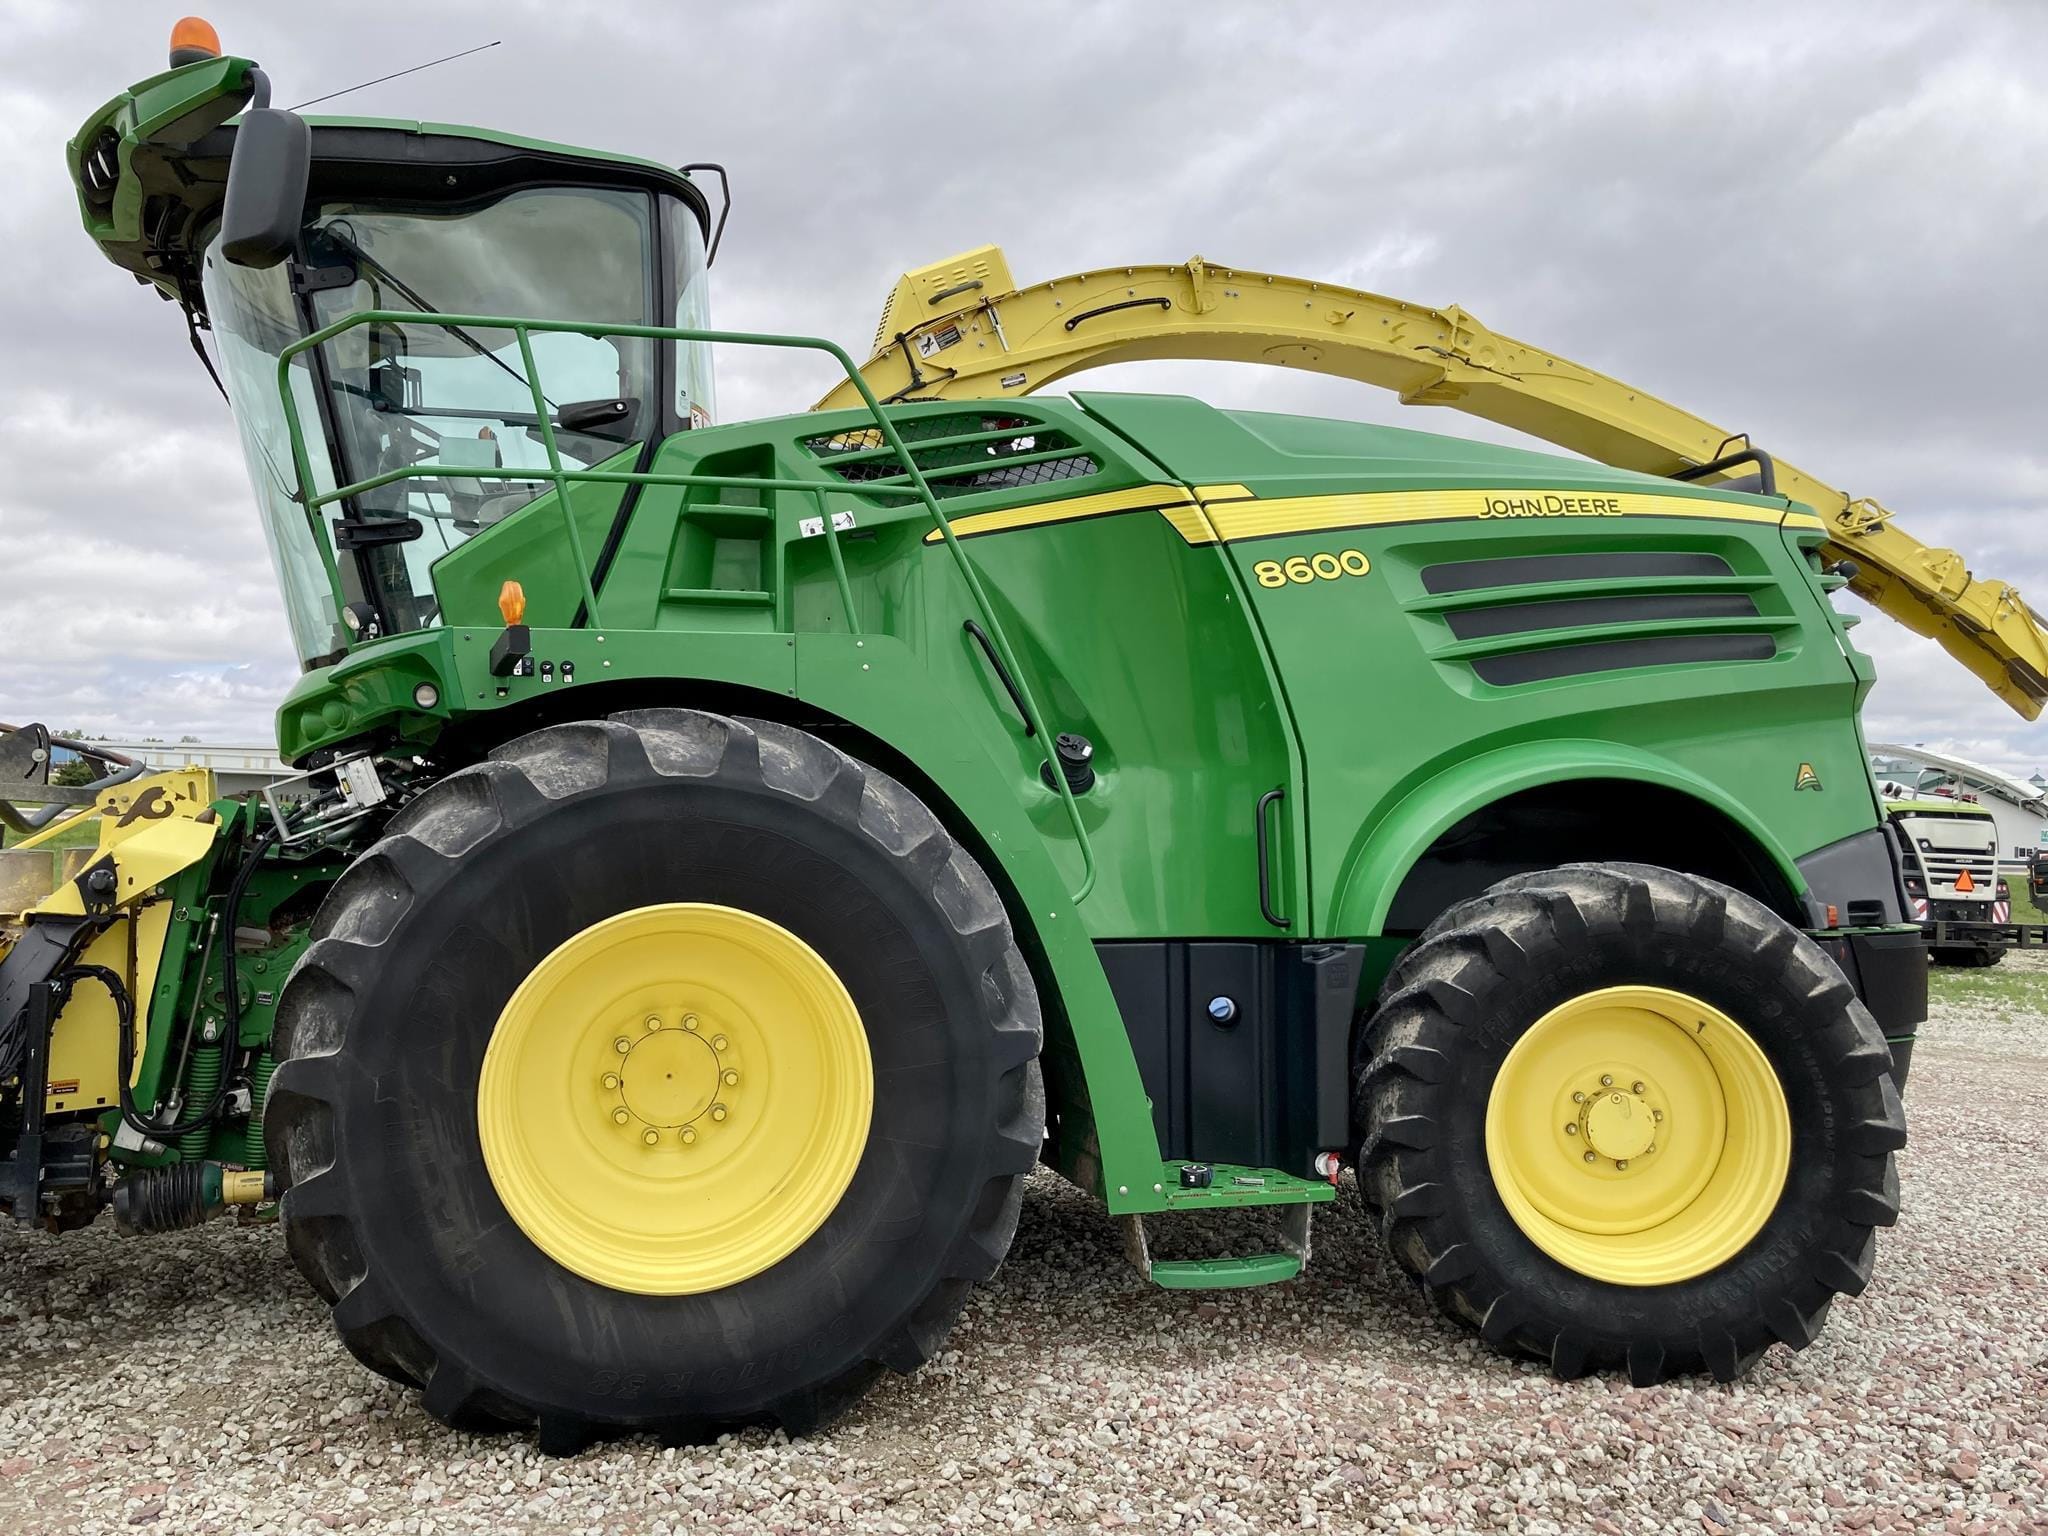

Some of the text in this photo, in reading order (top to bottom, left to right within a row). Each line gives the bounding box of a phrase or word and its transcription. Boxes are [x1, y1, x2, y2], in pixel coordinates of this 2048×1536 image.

[1480, 495, 1622, 516] JOHN DEERE
[1253, 549, 1370, 588] 8600
